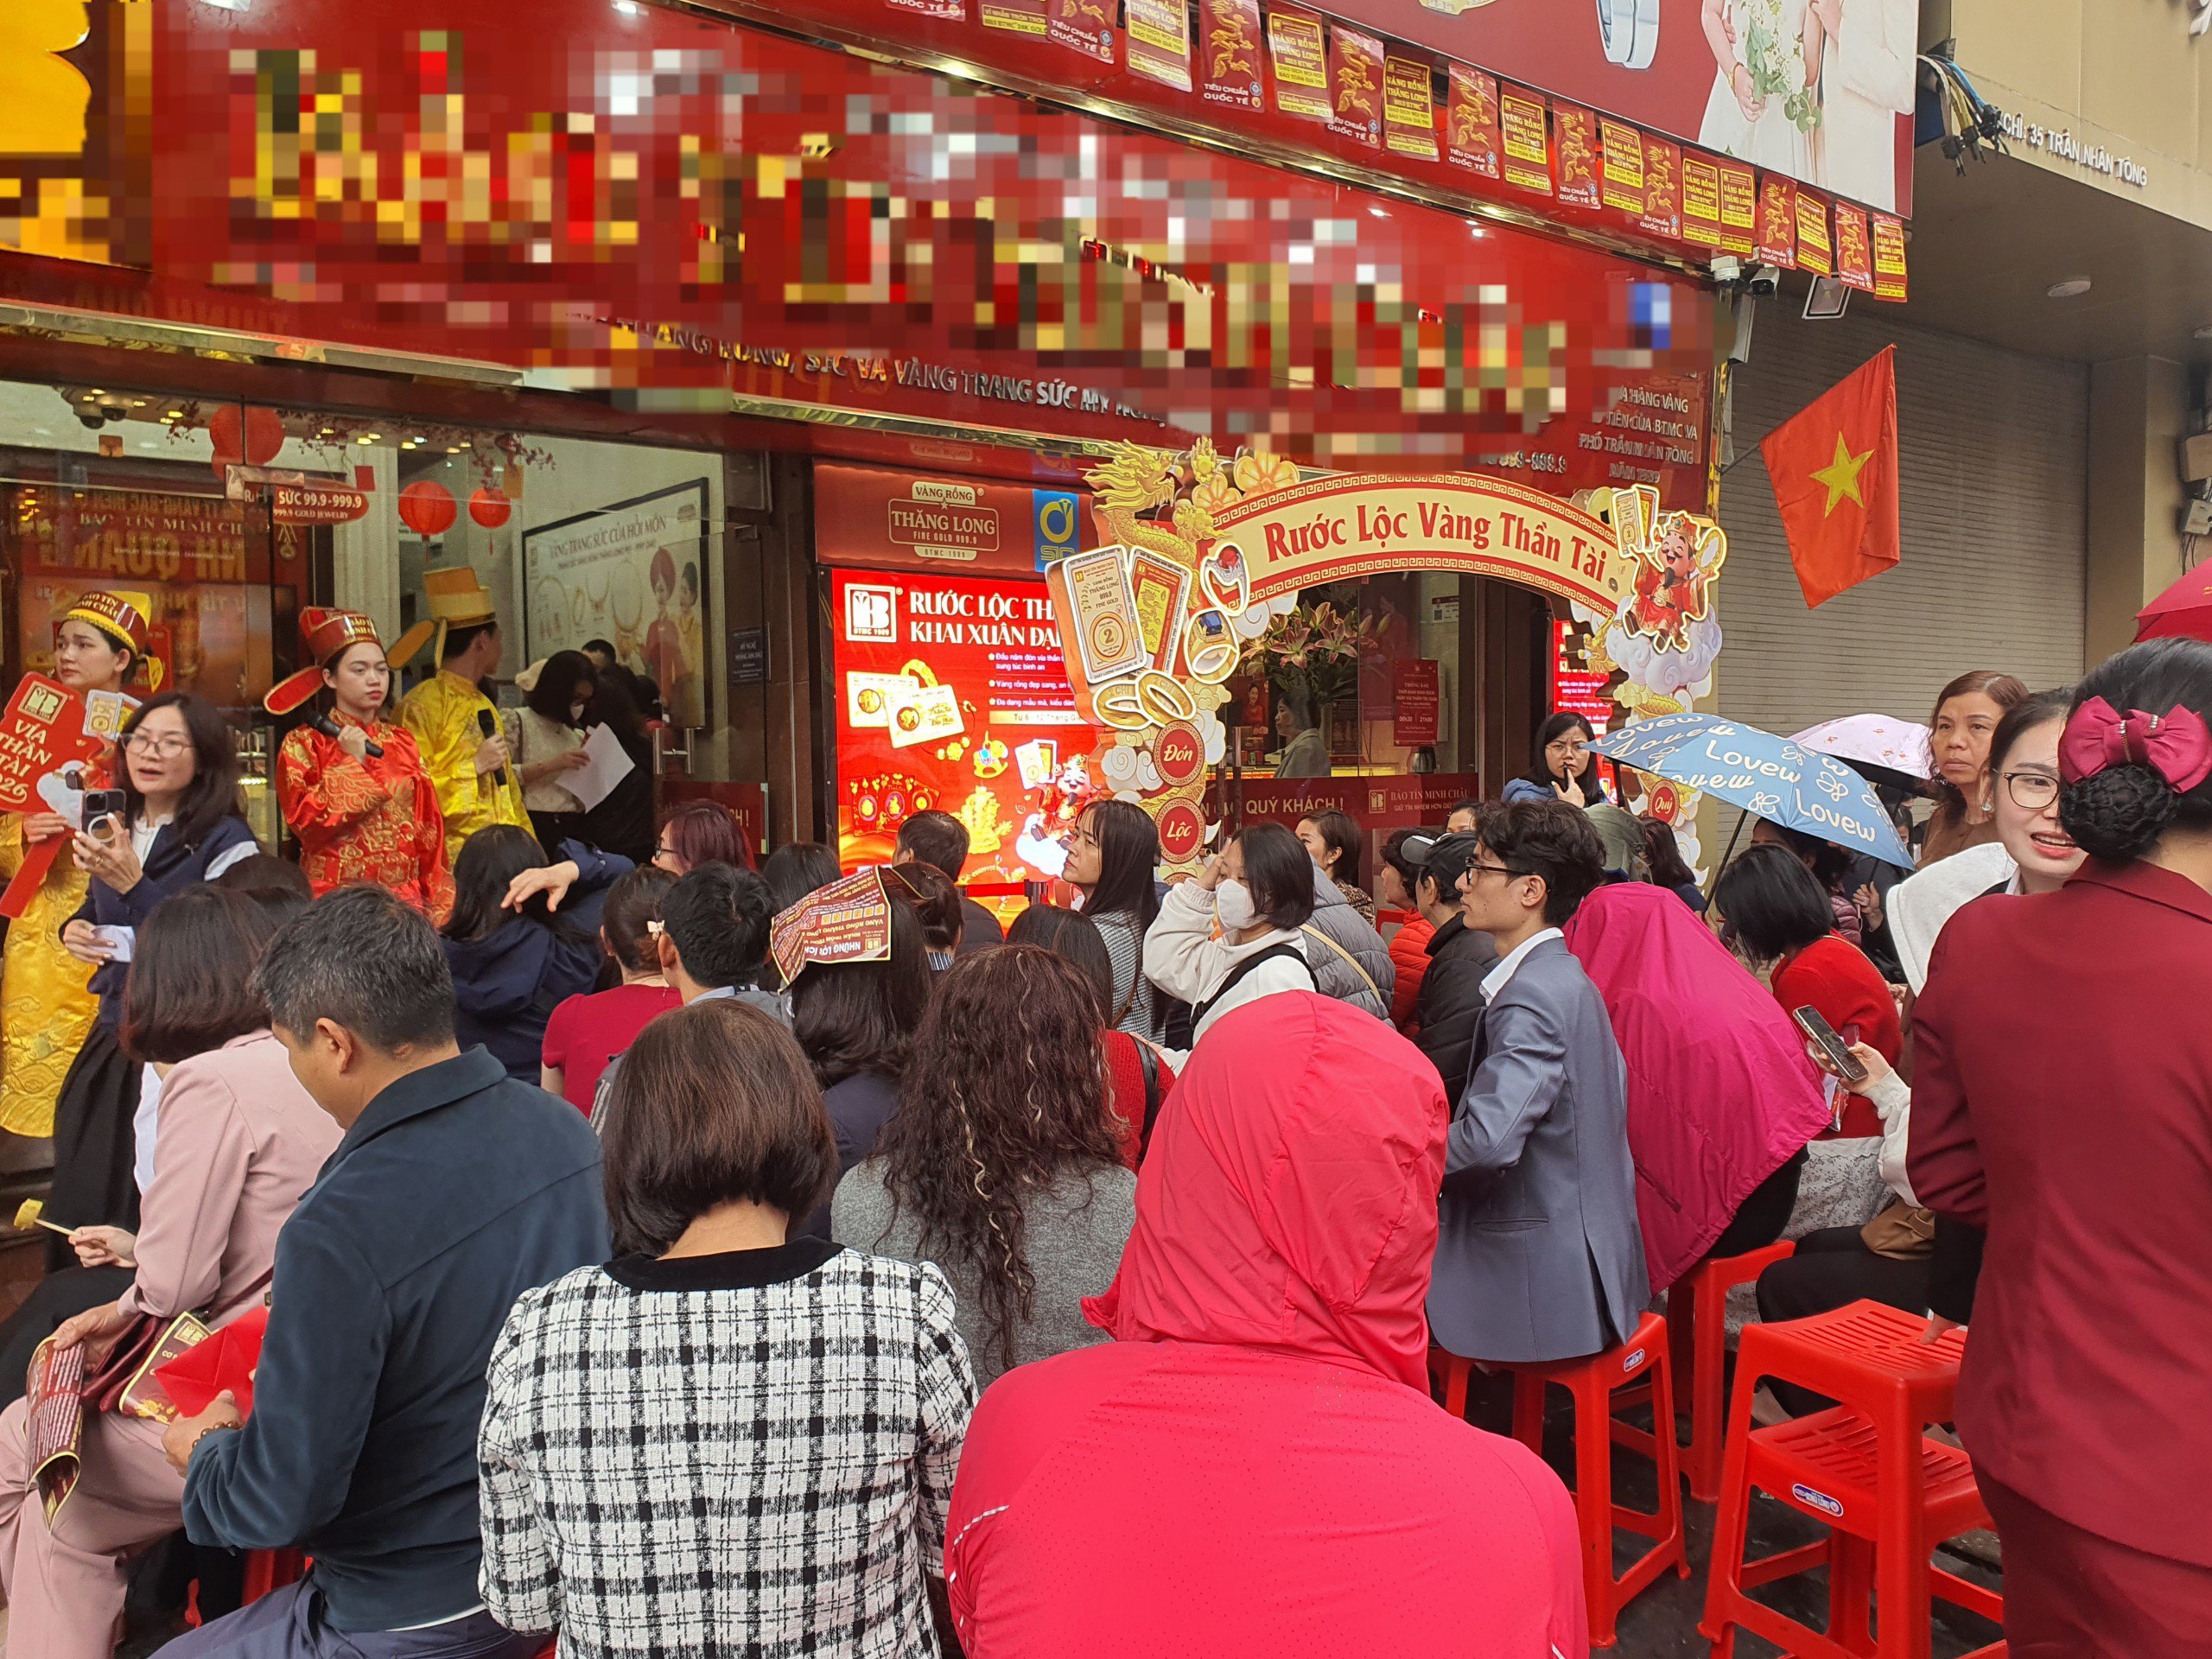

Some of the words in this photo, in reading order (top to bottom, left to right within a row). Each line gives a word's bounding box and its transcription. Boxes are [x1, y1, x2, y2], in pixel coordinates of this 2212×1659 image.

[1051, 29, 1079, 45] QUỐC
[1084, 41, 1097, 52] TẾ
[1204, 92, 1234, 103] QUỐC
[1236, 96, 1249, 105] TẾ
[2030, 122, 2044, 147] 35
[2048, 128, 2080, 162] TRẦN
[2083, 145, 2113, 175] NHÂN
[2117, 156, 2148, 187] TÔNG
[894, 356, 957, 391] VÀNG
[961, 369, 1032, 403] TRANG
[1037, 378, 1077, 409] SỨC
[1629, 386, 1660, 407] HÀNG
[1661, 392, 1688, 413] VÀNG
[1579, 431, 1602, 450] PHỐ
[1665, 446, 1694, 465] TÔNG
[916, 485, 944, 498] VÀNG
[945, 486, 973, 501] RỒNG
[891, 509, 949, 531] THĂNG
[953, 516, 995, 535] LONG
[913, 531, 931, 541] FINE
[934, 533, 952, 543] GOLD
[956, 534, 977, 544] 999.9
[1263, 510, 1349, 563] Rước
[1357, 503, 1409, 547] Lộc
[1417, 501, 1490, 549] Vàng
[1499, 509, 1561, 563] Thần
[1571, 536, 1607, 582] Tài
[948, 550, 965, 558] 1989
[910, 588, 974, 616] RƯỚC
[979, 593, 1020, 621] LỘC
[910, 621, 964, 644] KHAI
[969, 621, 1027, 646] XUÂN
[1103, 629, 1114, 644] 2
[15, 718, 47, 745] VÍA
[1163, 743, 1193, 763] Đón
[1706, 739, 1802, 784] Lovew
[1246, 795, 1284, 815] QUÝ
[1286, 796, 1335, 814] KHÁCH
[1391, 791, 1408, 800] BẢO
[1409, 789, 1423, 800] TÍN
[1426, 790, 1446, 799] MINH
[1448, 787, 1469, 798] CHÂU
[1656, 796, 1673, 814] Quý
[1796, 788, 1876, 842] Lovew
[1166, 819, 1192, 840] Lộc
[865, 918, 884, 927] VÀNG
